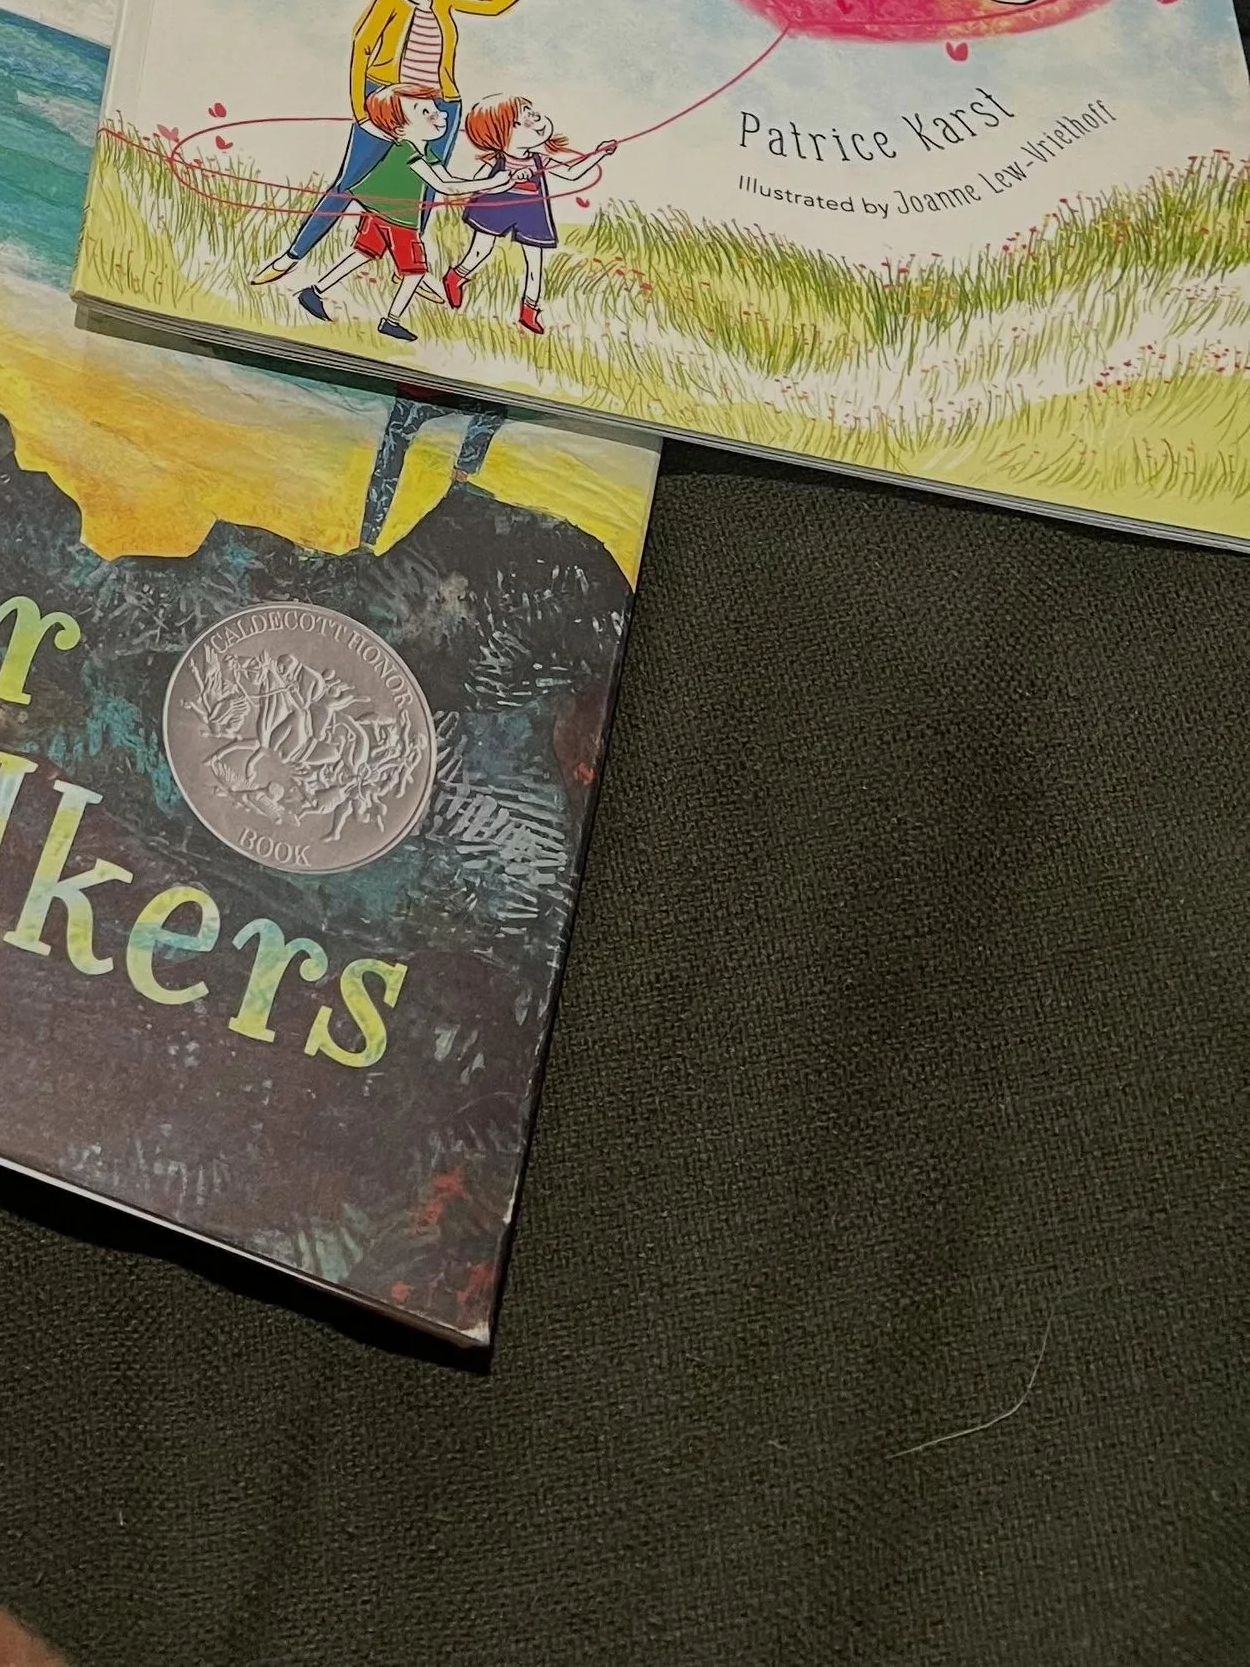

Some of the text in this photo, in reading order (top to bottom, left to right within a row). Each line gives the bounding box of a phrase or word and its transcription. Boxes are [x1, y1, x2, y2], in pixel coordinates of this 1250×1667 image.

[739, 87, 1015, 162] Patrice Karst
[739, 99, 1117, 220] Illustrated by Joanne Lew-Vriethoff
[210, 612, 414, 708] CALDECOTT HONOR
[239, 827, 312, 867] BOOK
